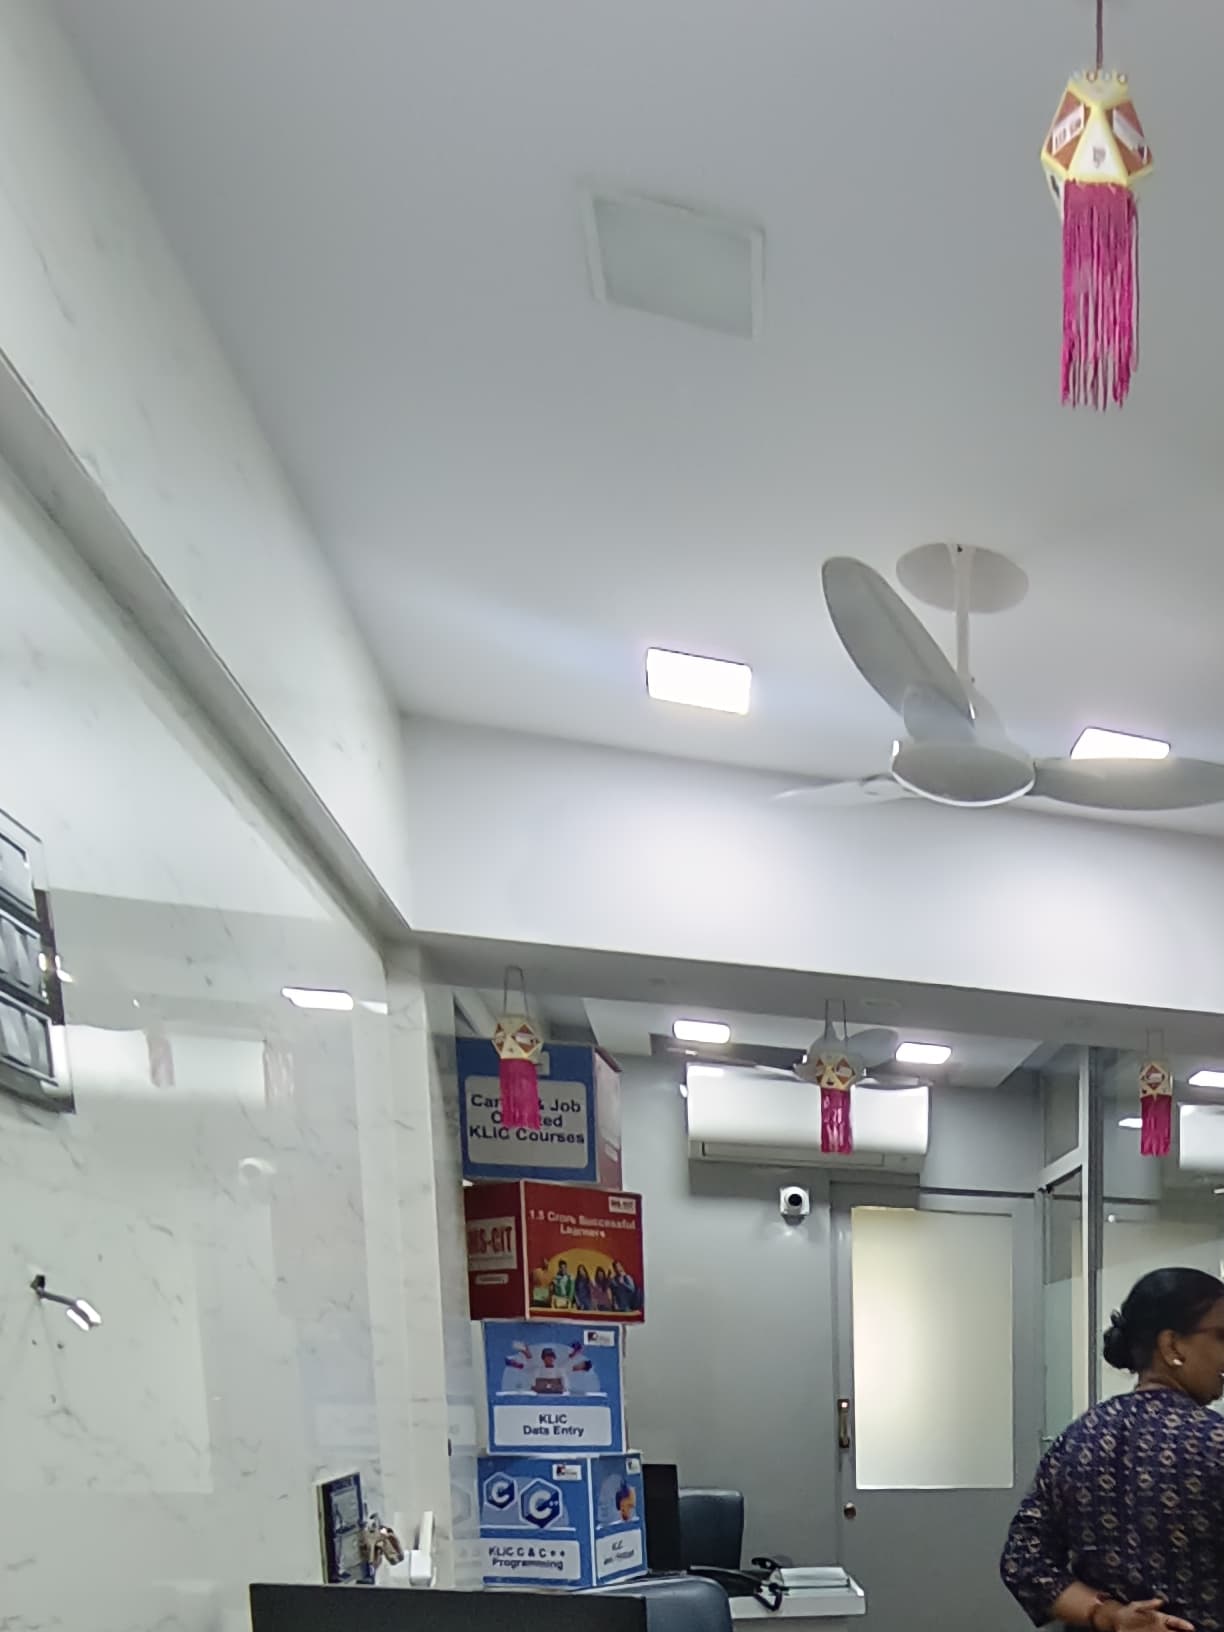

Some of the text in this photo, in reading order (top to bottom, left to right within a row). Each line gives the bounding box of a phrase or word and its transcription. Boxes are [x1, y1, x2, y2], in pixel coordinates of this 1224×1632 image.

[550, 1099, 581, 1112] Job
[515, 1128, 585, 1144] Courses
[553, 1425, 584, 1437] Entry
[491, 1481, 510, 1504] C
